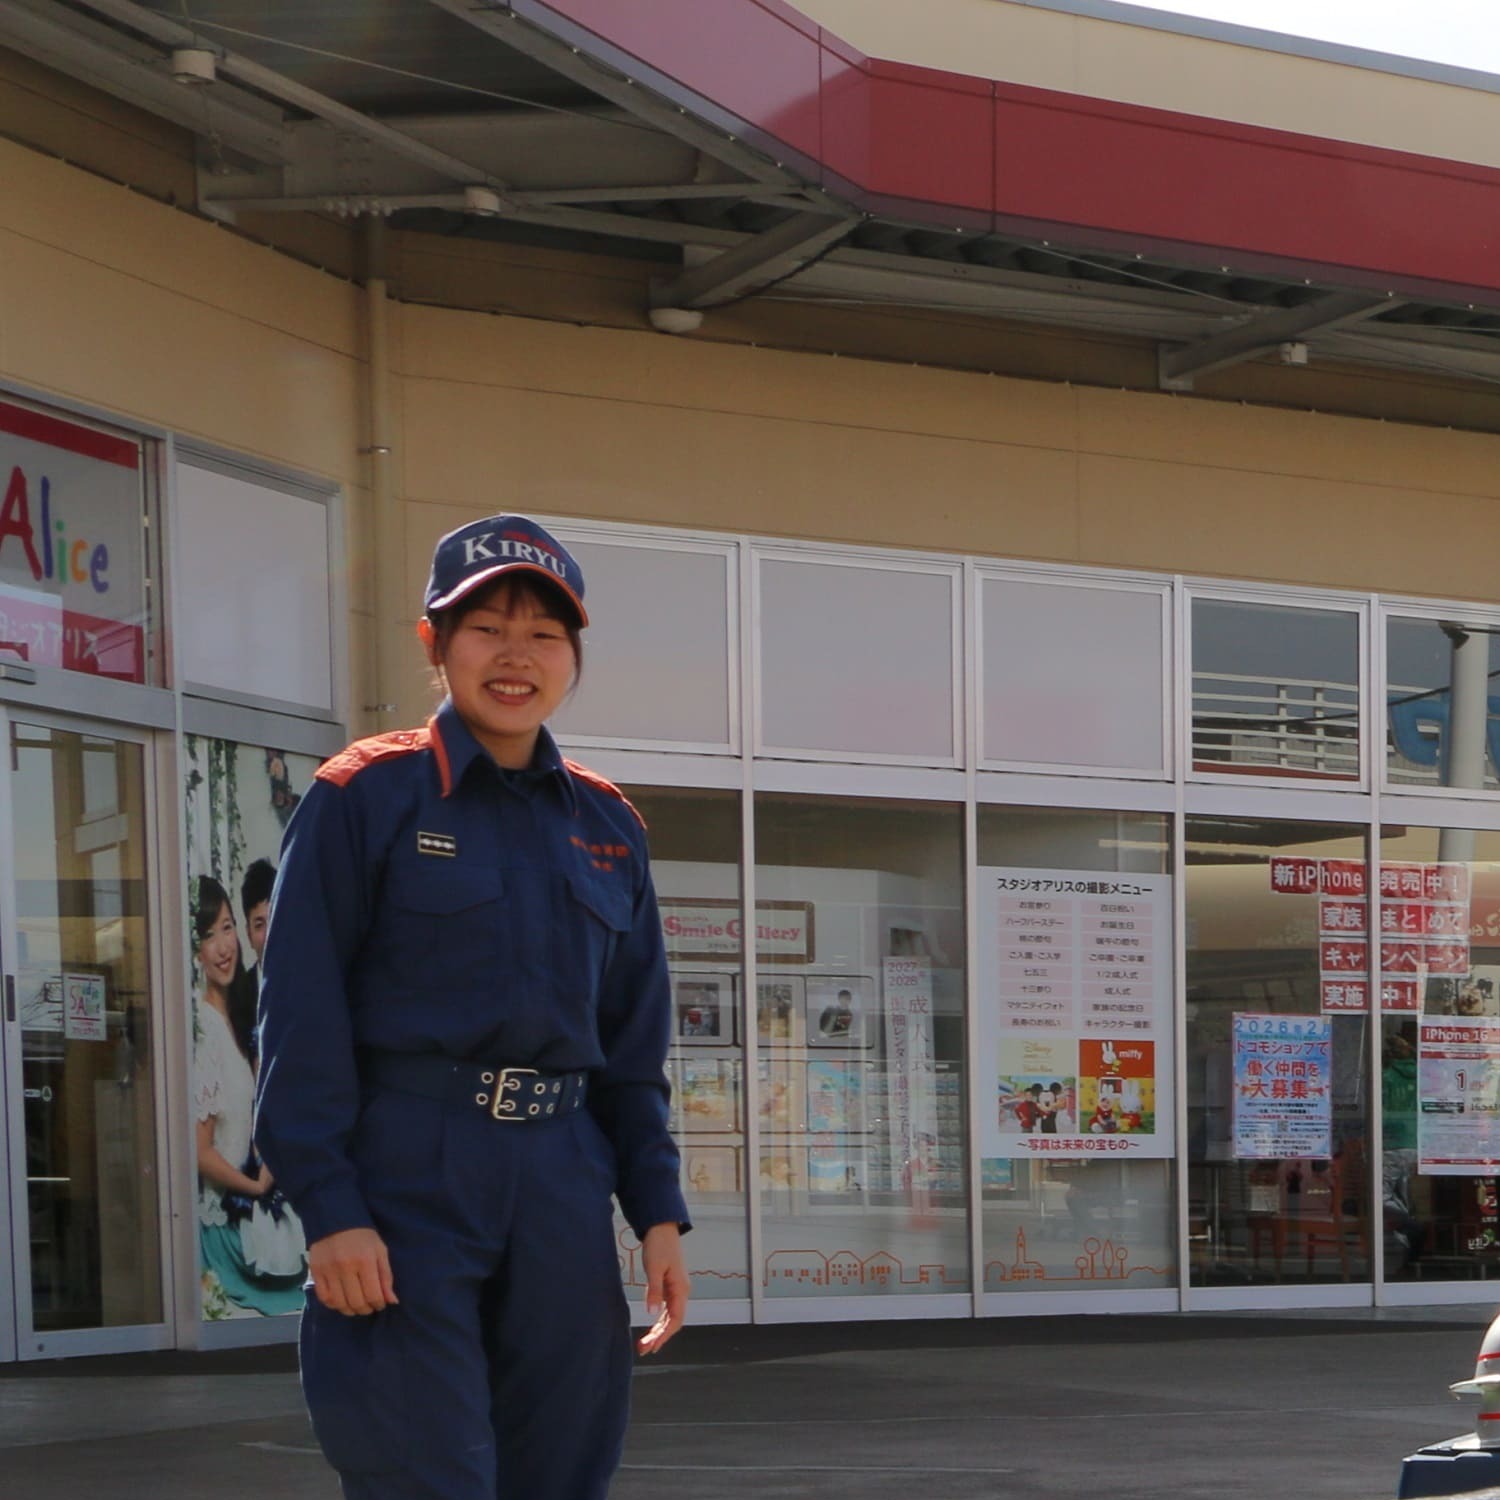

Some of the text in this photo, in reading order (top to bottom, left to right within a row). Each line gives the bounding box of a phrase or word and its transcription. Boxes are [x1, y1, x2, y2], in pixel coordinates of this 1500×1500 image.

[0, 465, 109, 593] Alice
[462, 532, 566, 578] KIRYU
[664, 916, 723, 938] Smile
[1325, 947, 1467, 971] キャンペーン
[1425, 1027, 1470, 1042] iPhone
[1118, 1049, 1143, 1061] miffy
